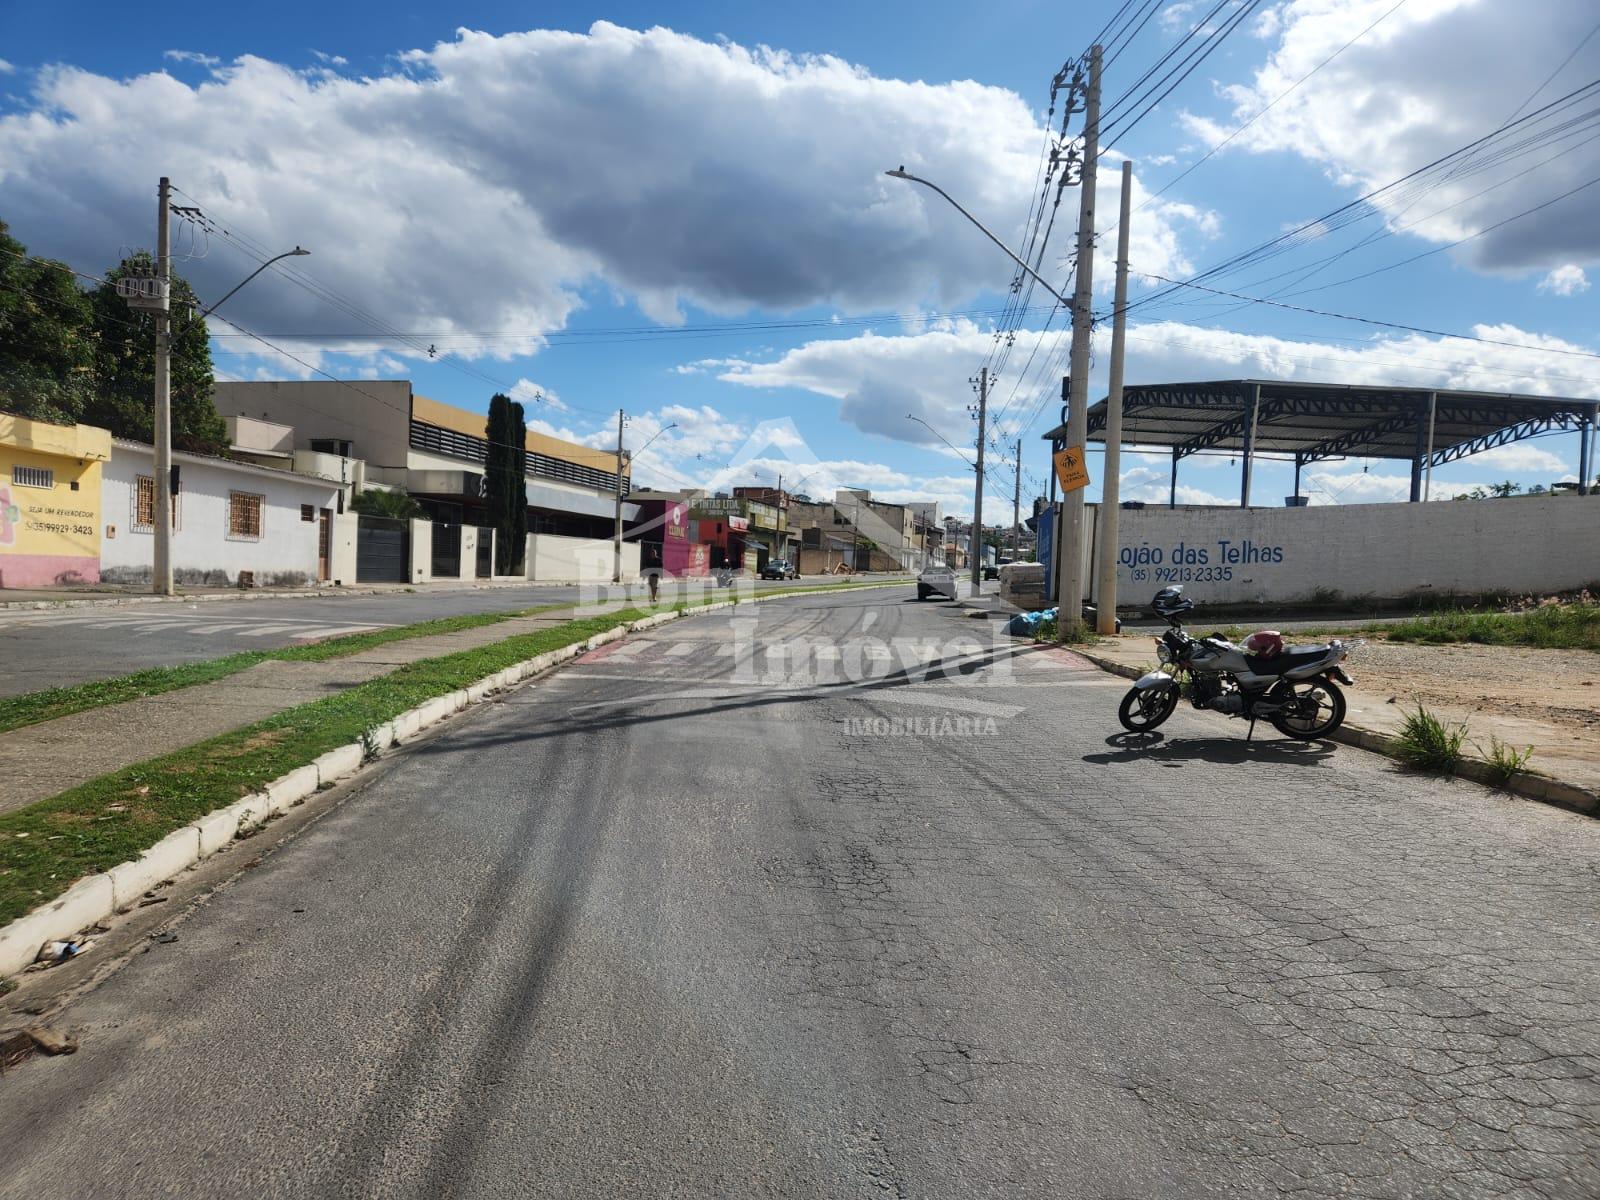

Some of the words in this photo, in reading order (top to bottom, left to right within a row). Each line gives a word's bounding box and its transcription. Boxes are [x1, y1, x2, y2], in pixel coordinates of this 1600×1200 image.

[1117, 541, 1163, 568] ojão
[1171, 541, 1209, 565] das
[1218, 540, 1284, 564] Telhas
[1130, 568, 1151, 583] (35)
[1155, 566, 1233, 583] 99213-2335
